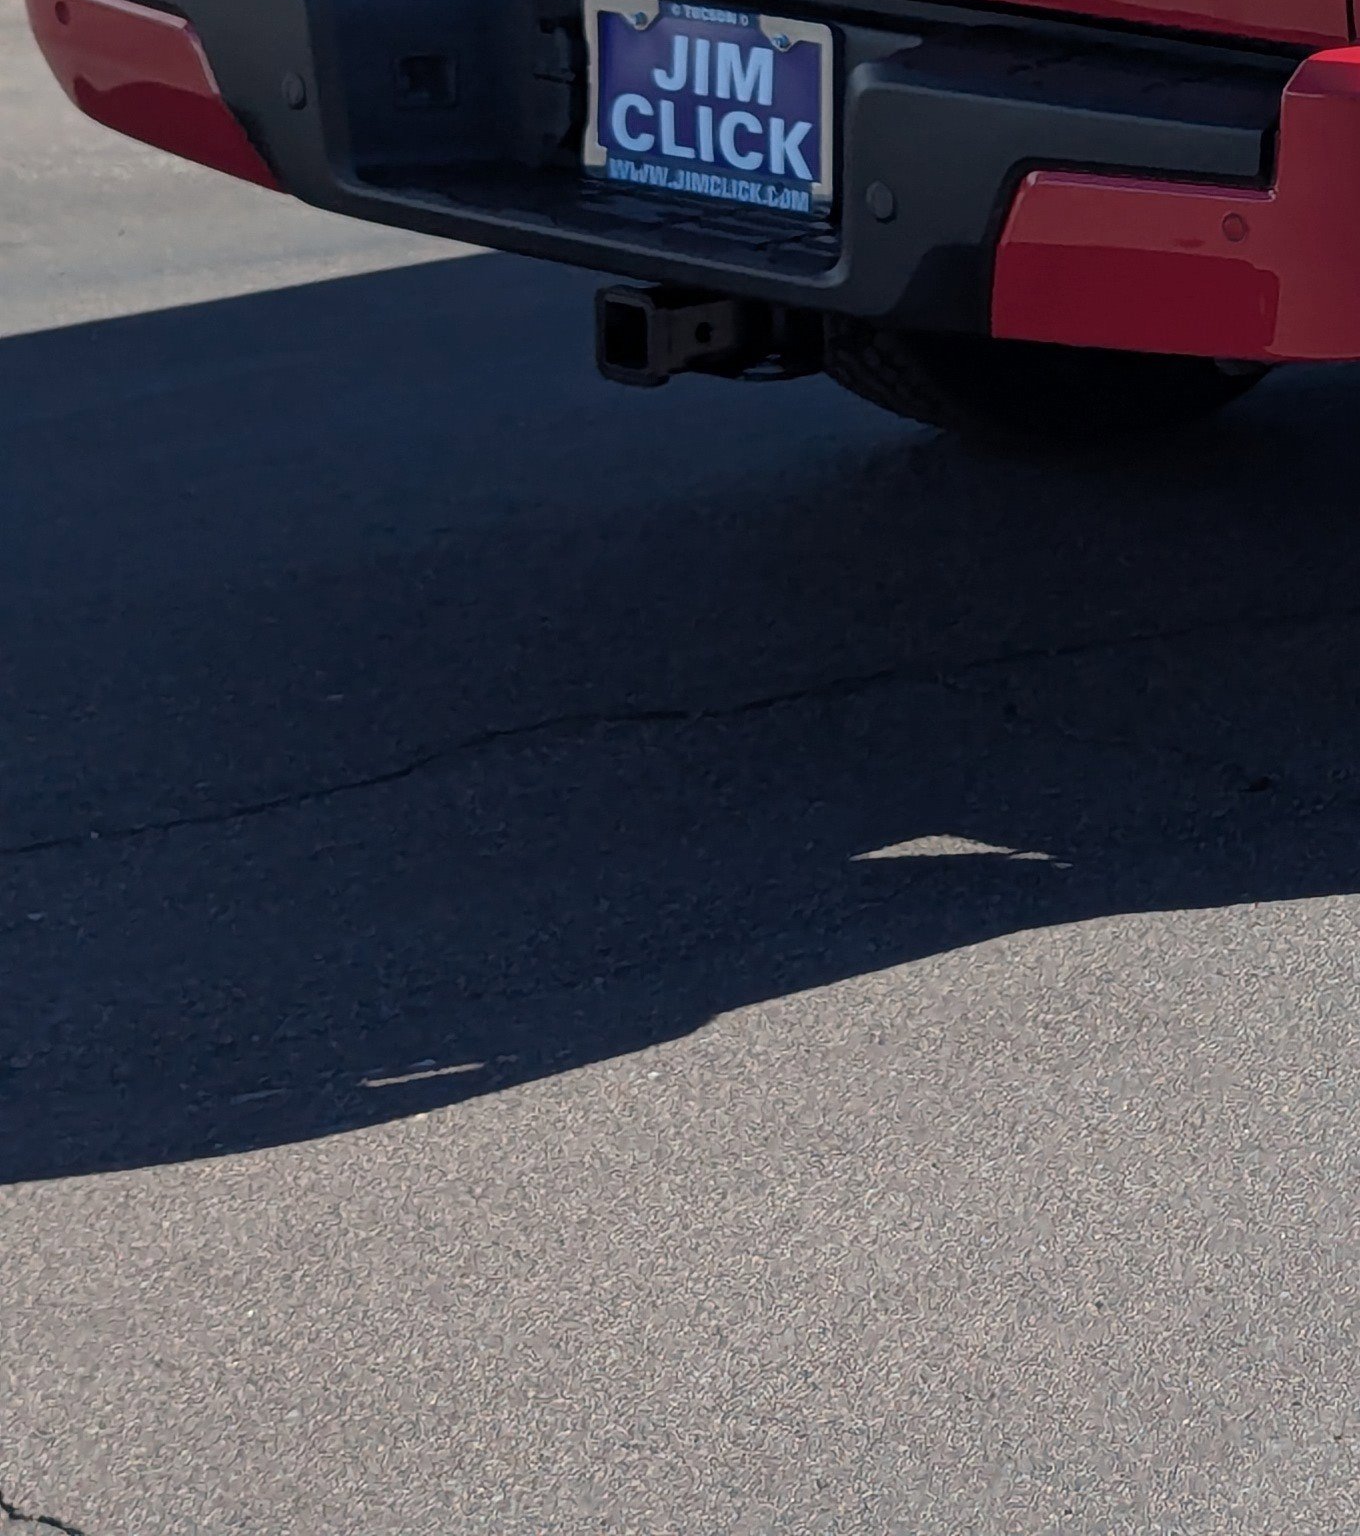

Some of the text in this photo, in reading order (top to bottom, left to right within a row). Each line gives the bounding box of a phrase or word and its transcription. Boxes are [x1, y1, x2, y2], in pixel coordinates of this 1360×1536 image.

[653, 35, 774, 106] JIM
[611, 93, 814, 182] CLICK
[608, 158, 810, 213] WWW.JIMCLICK.COM
